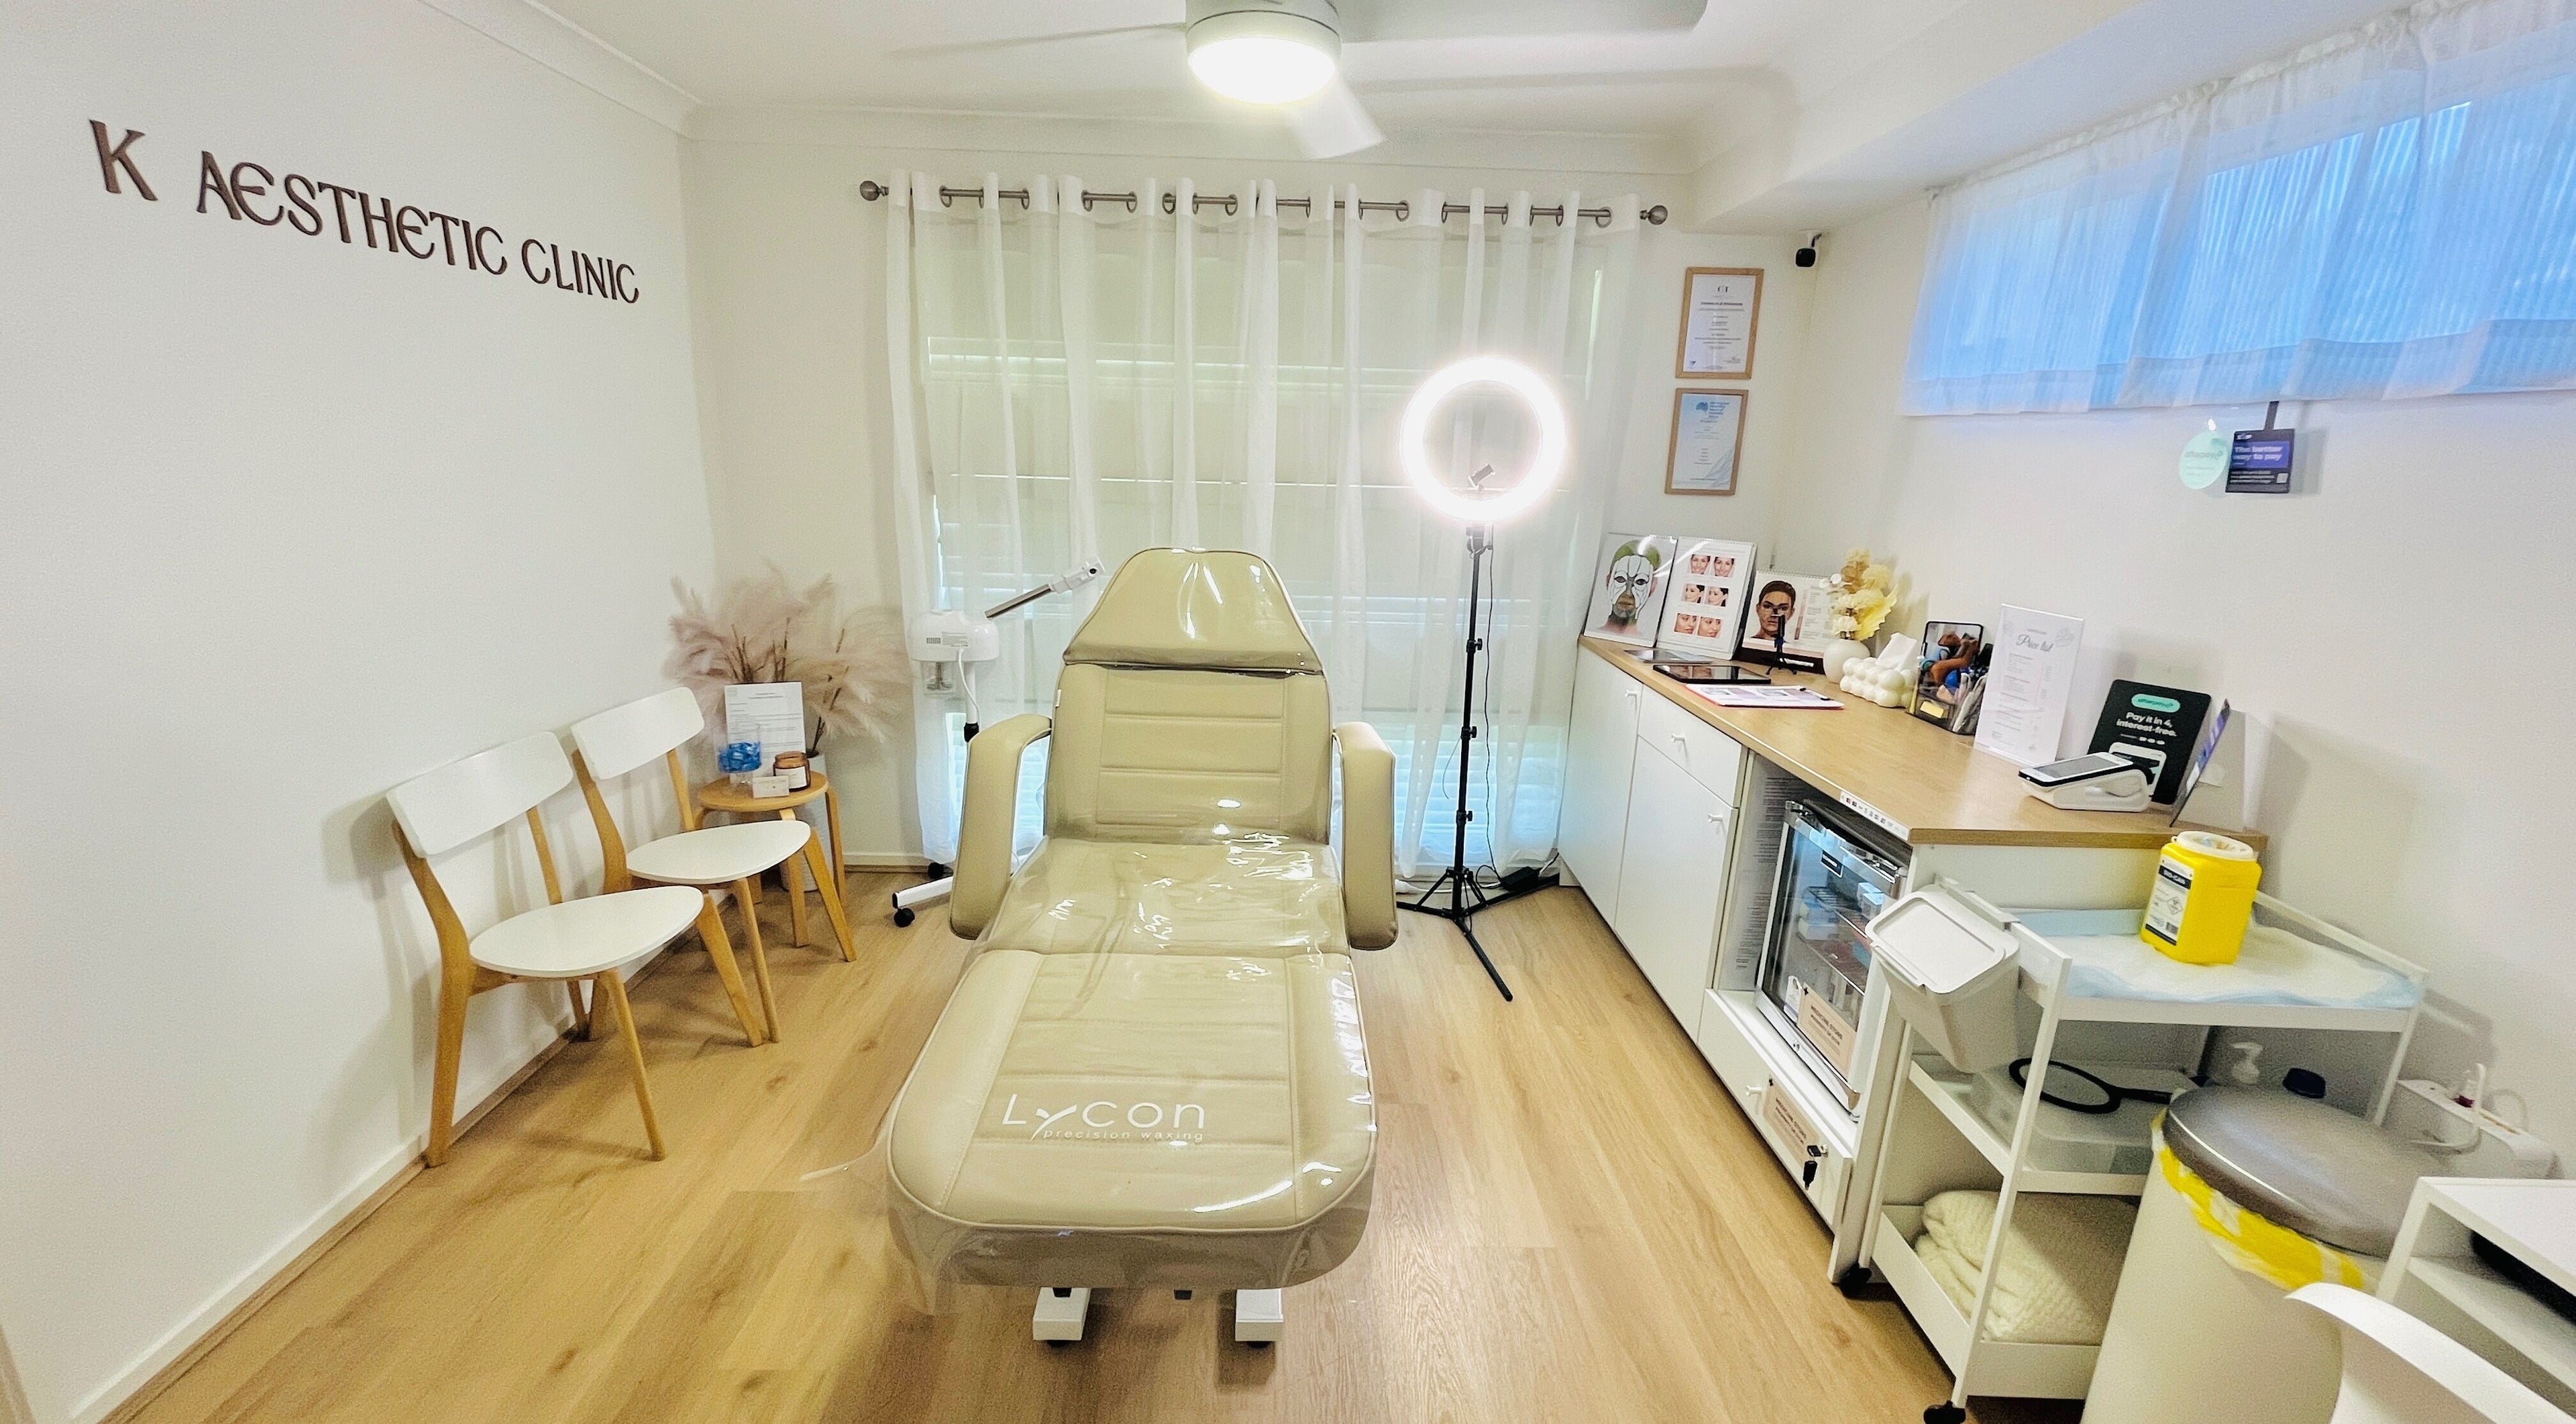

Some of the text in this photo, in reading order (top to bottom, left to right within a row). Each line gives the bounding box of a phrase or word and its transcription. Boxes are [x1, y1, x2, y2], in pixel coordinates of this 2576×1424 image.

[90, 119, 640, 304] K AESTHETIC CLINIC
[2126, 712, 2146, 723] Pay
[2145, 715, 2153, 723] it
[2153, 716, 2163, 725] in
[1043, 1129, 1204, 1142] precision waxing
